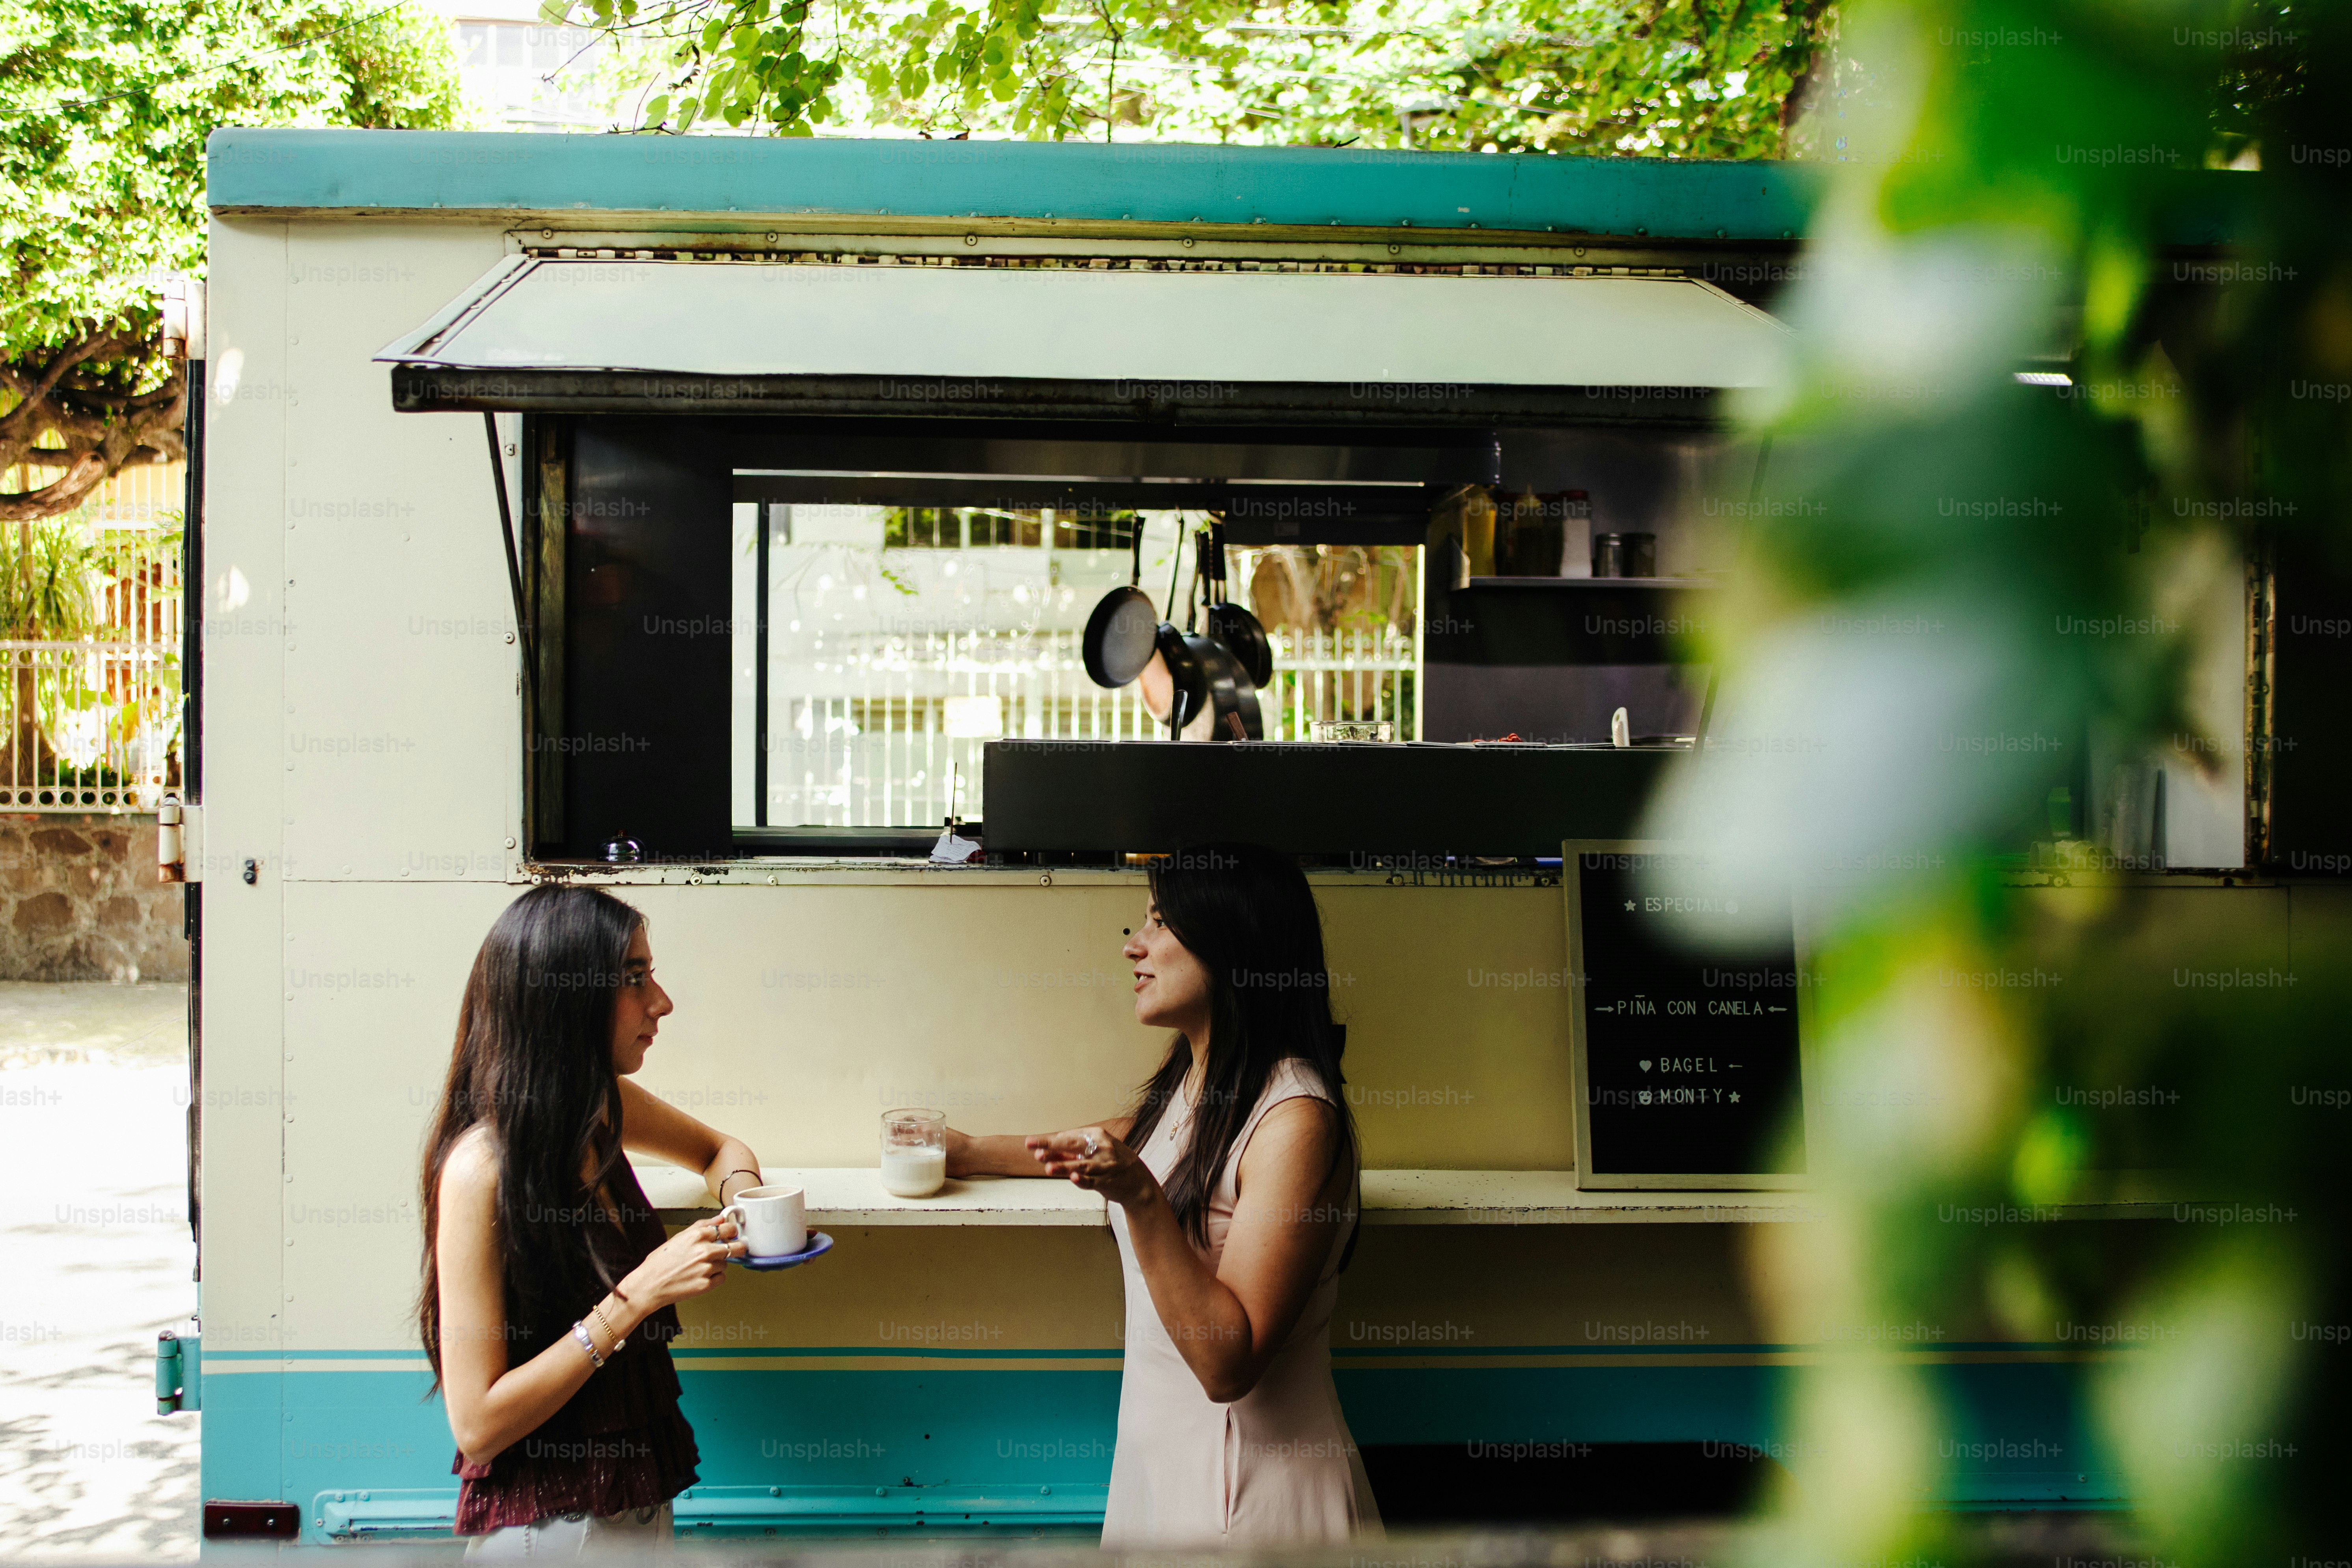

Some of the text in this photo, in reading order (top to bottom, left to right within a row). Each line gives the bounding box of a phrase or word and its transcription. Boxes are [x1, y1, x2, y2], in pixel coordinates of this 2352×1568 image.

[1645, 897, 1723, 913] ESPECIAL
[1618, 995, 1763, 1015] PIÑA CON CANELA
[1661, 1057, 1717, 1073] BAGEL
[1661, 1088, 1722, 1103] MONTY
